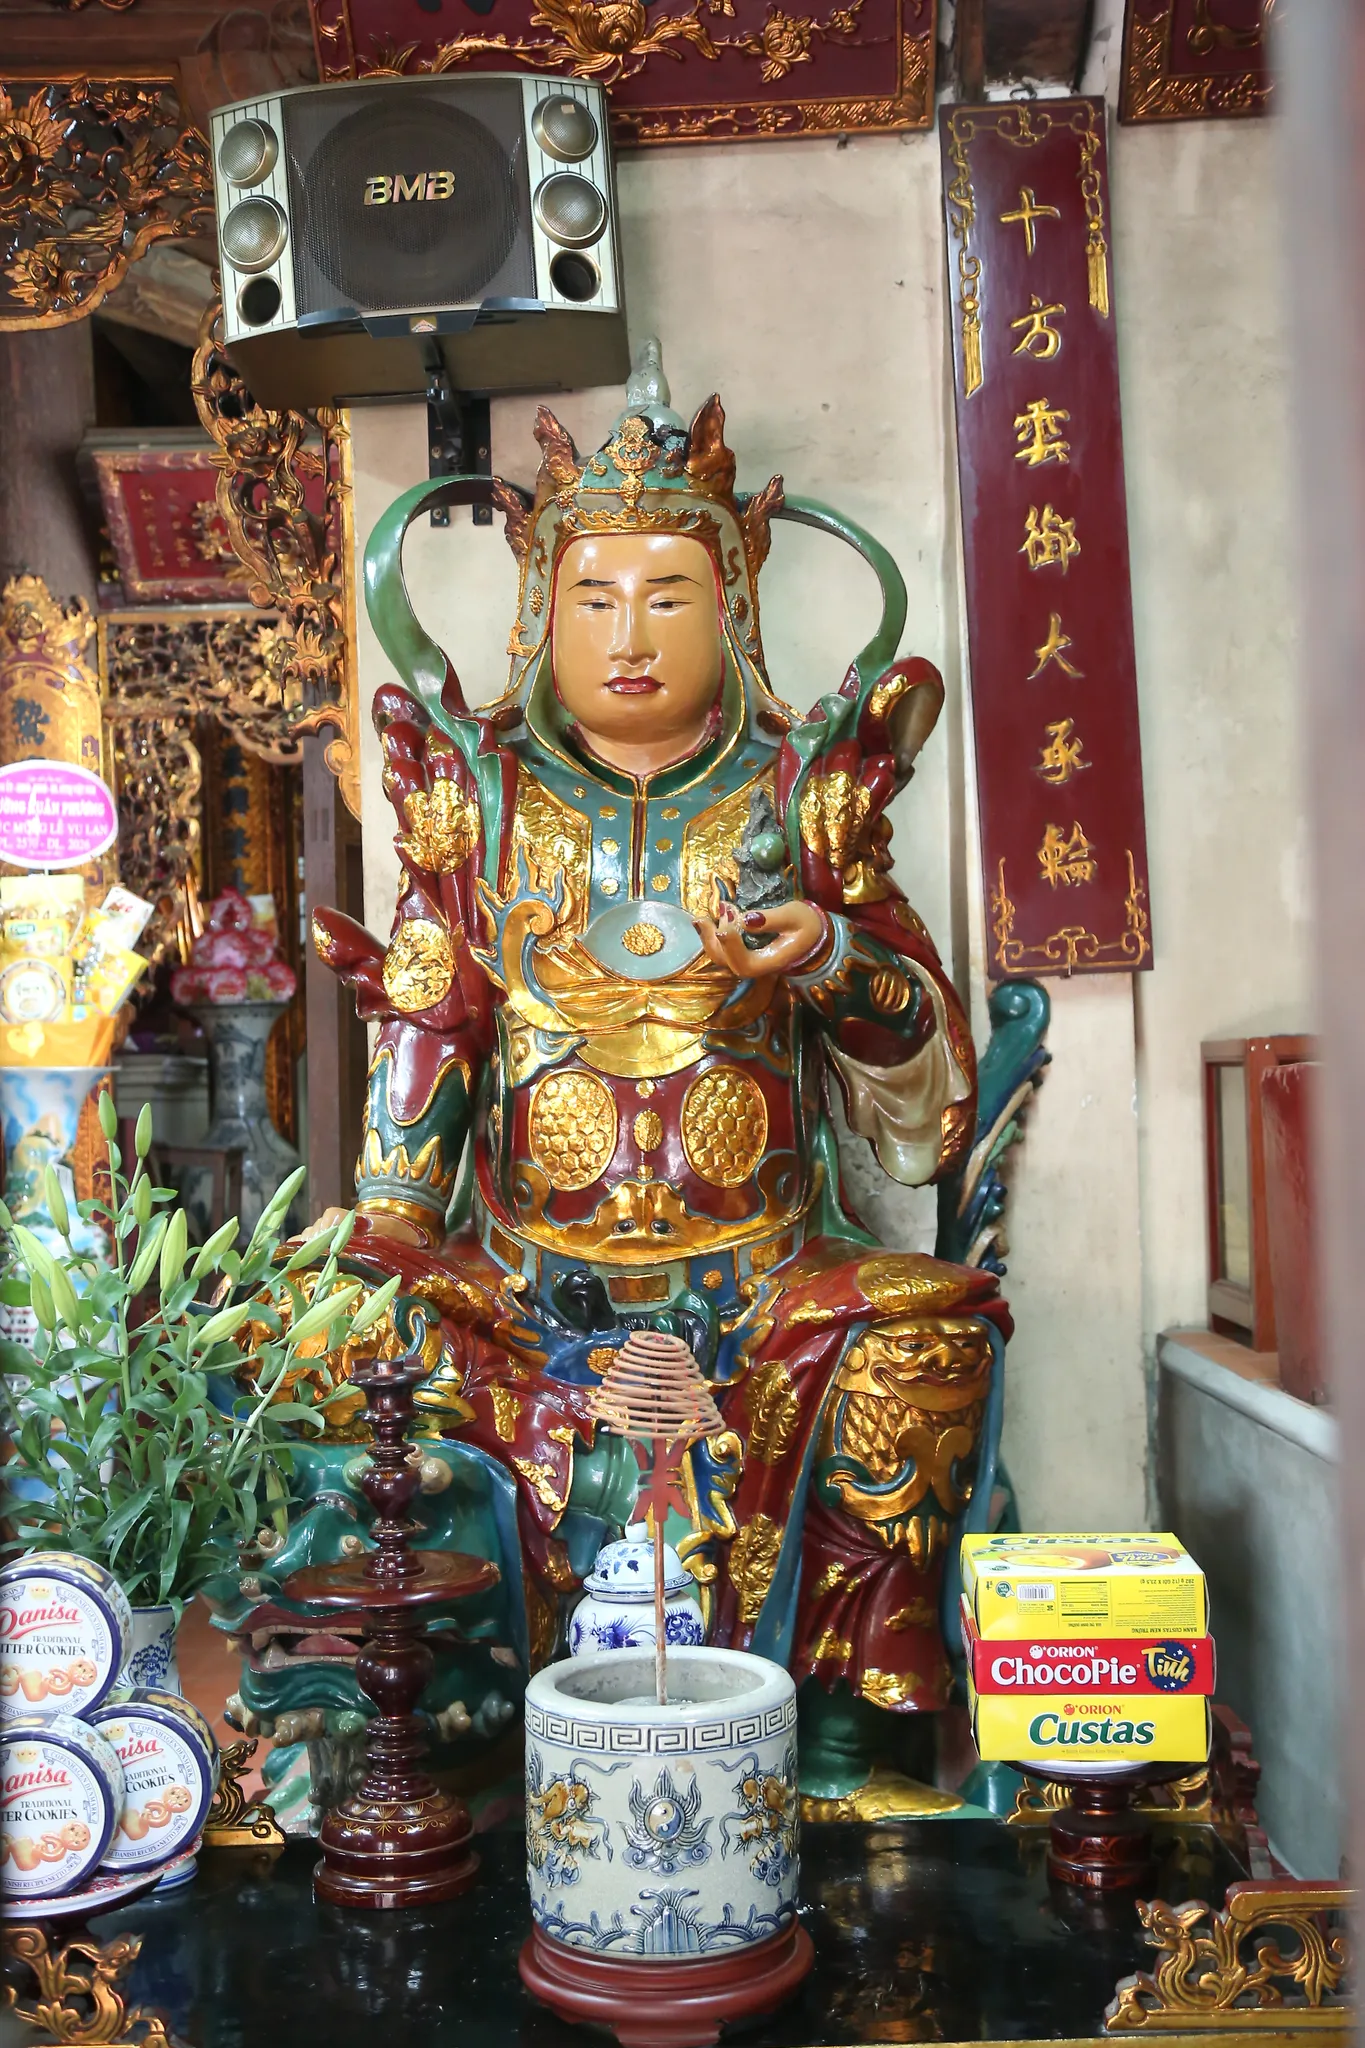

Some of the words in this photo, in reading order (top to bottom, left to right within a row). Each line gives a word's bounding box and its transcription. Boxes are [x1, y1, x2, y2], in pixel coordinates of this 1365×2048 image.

[363, 171, 456, 205] BMB
[67, 823, 82, 835] VU
[86, 823, 108, 836] LAN
[32, 1635, 82, 1645] TRADITIONAL
[35, 1643, 86, 1656] COOKIES
[1046, 1646, 1095, 1658] ORION
[991, 1657, 1137, 1686] ChocoPie
[1079, 1704, 1122, 1715] ORION
[1029, 1713, 1155, 1746] Custas
[0, 1761, 68, 1793] anisa
[126, 1773, 176, 1794] COOKIES
[21, 1799, 72, 1809] TRADITIONAL
[25, 1808, 78, 1821] COOKIES
